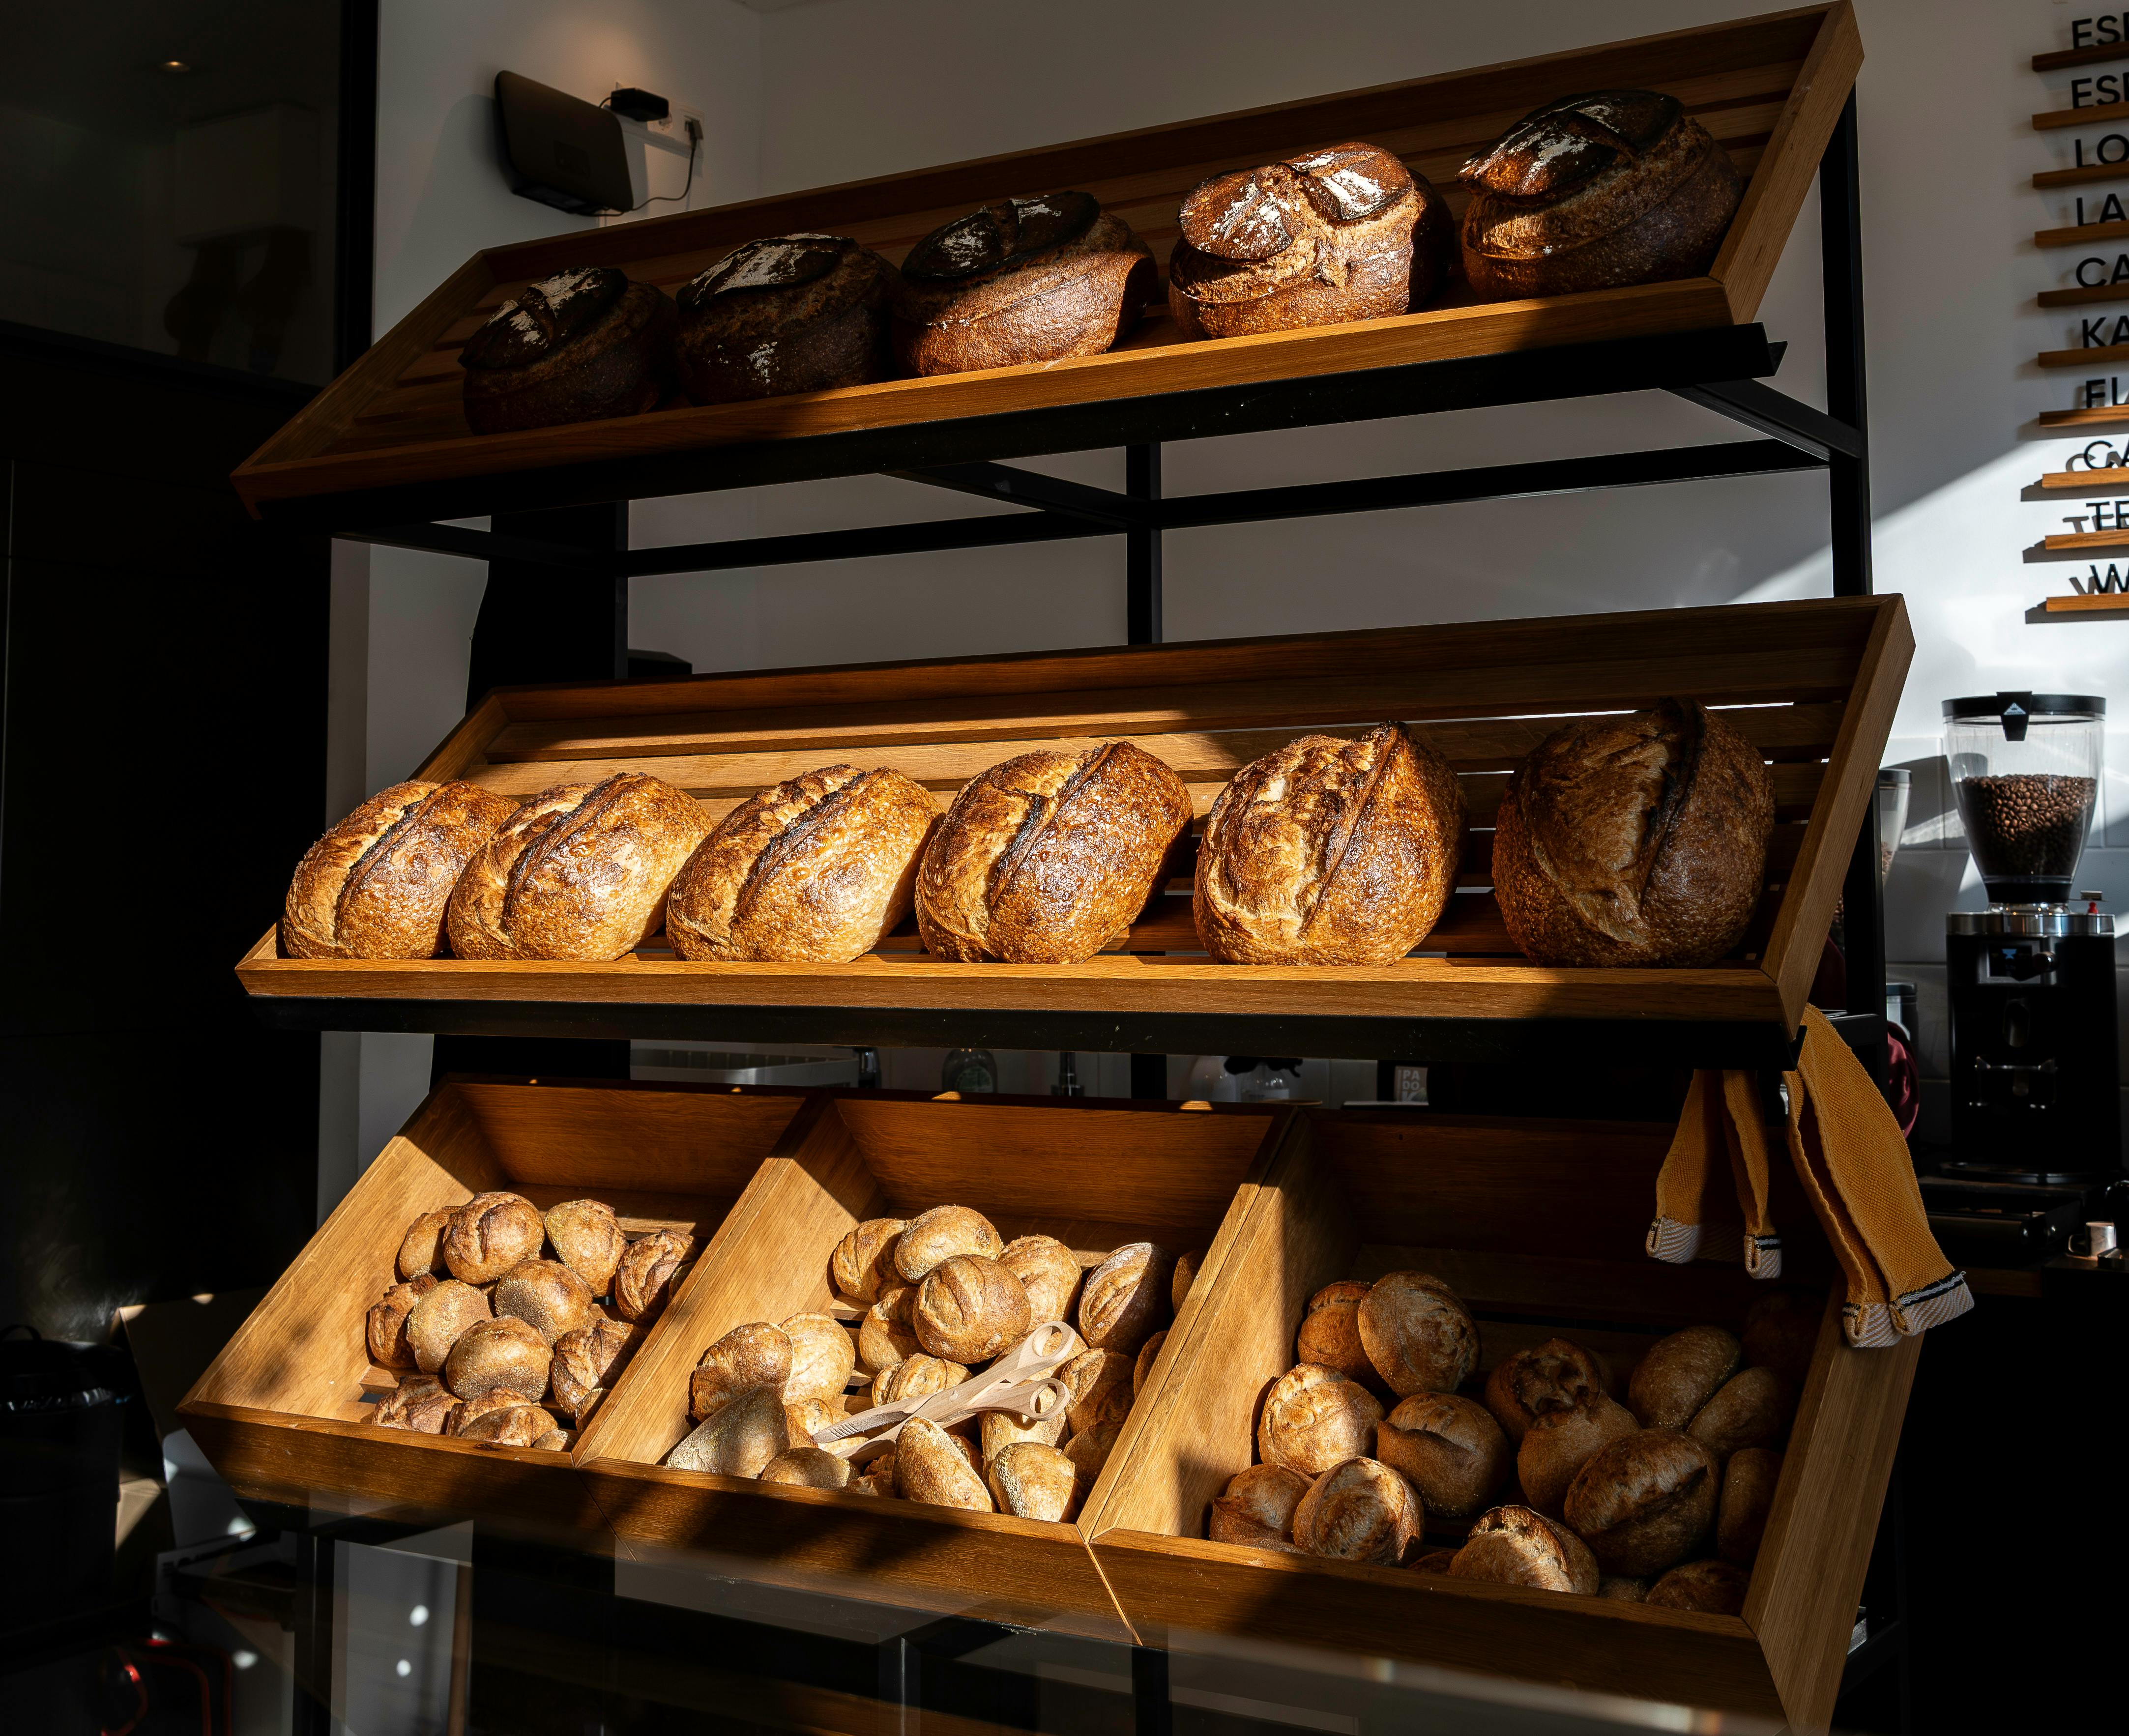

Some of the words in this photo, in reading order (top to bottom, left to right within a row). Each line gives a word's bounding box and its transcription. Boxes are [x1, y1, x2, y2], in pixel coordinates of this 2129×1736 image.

[2072, 12, 2129, 49] ES
[2072, 72, 2129, 109] ES
[2075, 134, 2129, 168] LO
[2077, 194, 2127, 226] LA
[2076, 254, 2129, 288] CA
[2082, 316, 2129, 348] KA
[2089, 563, 2129, 593] W
[1403, 1070, 1420, 1080] PA
